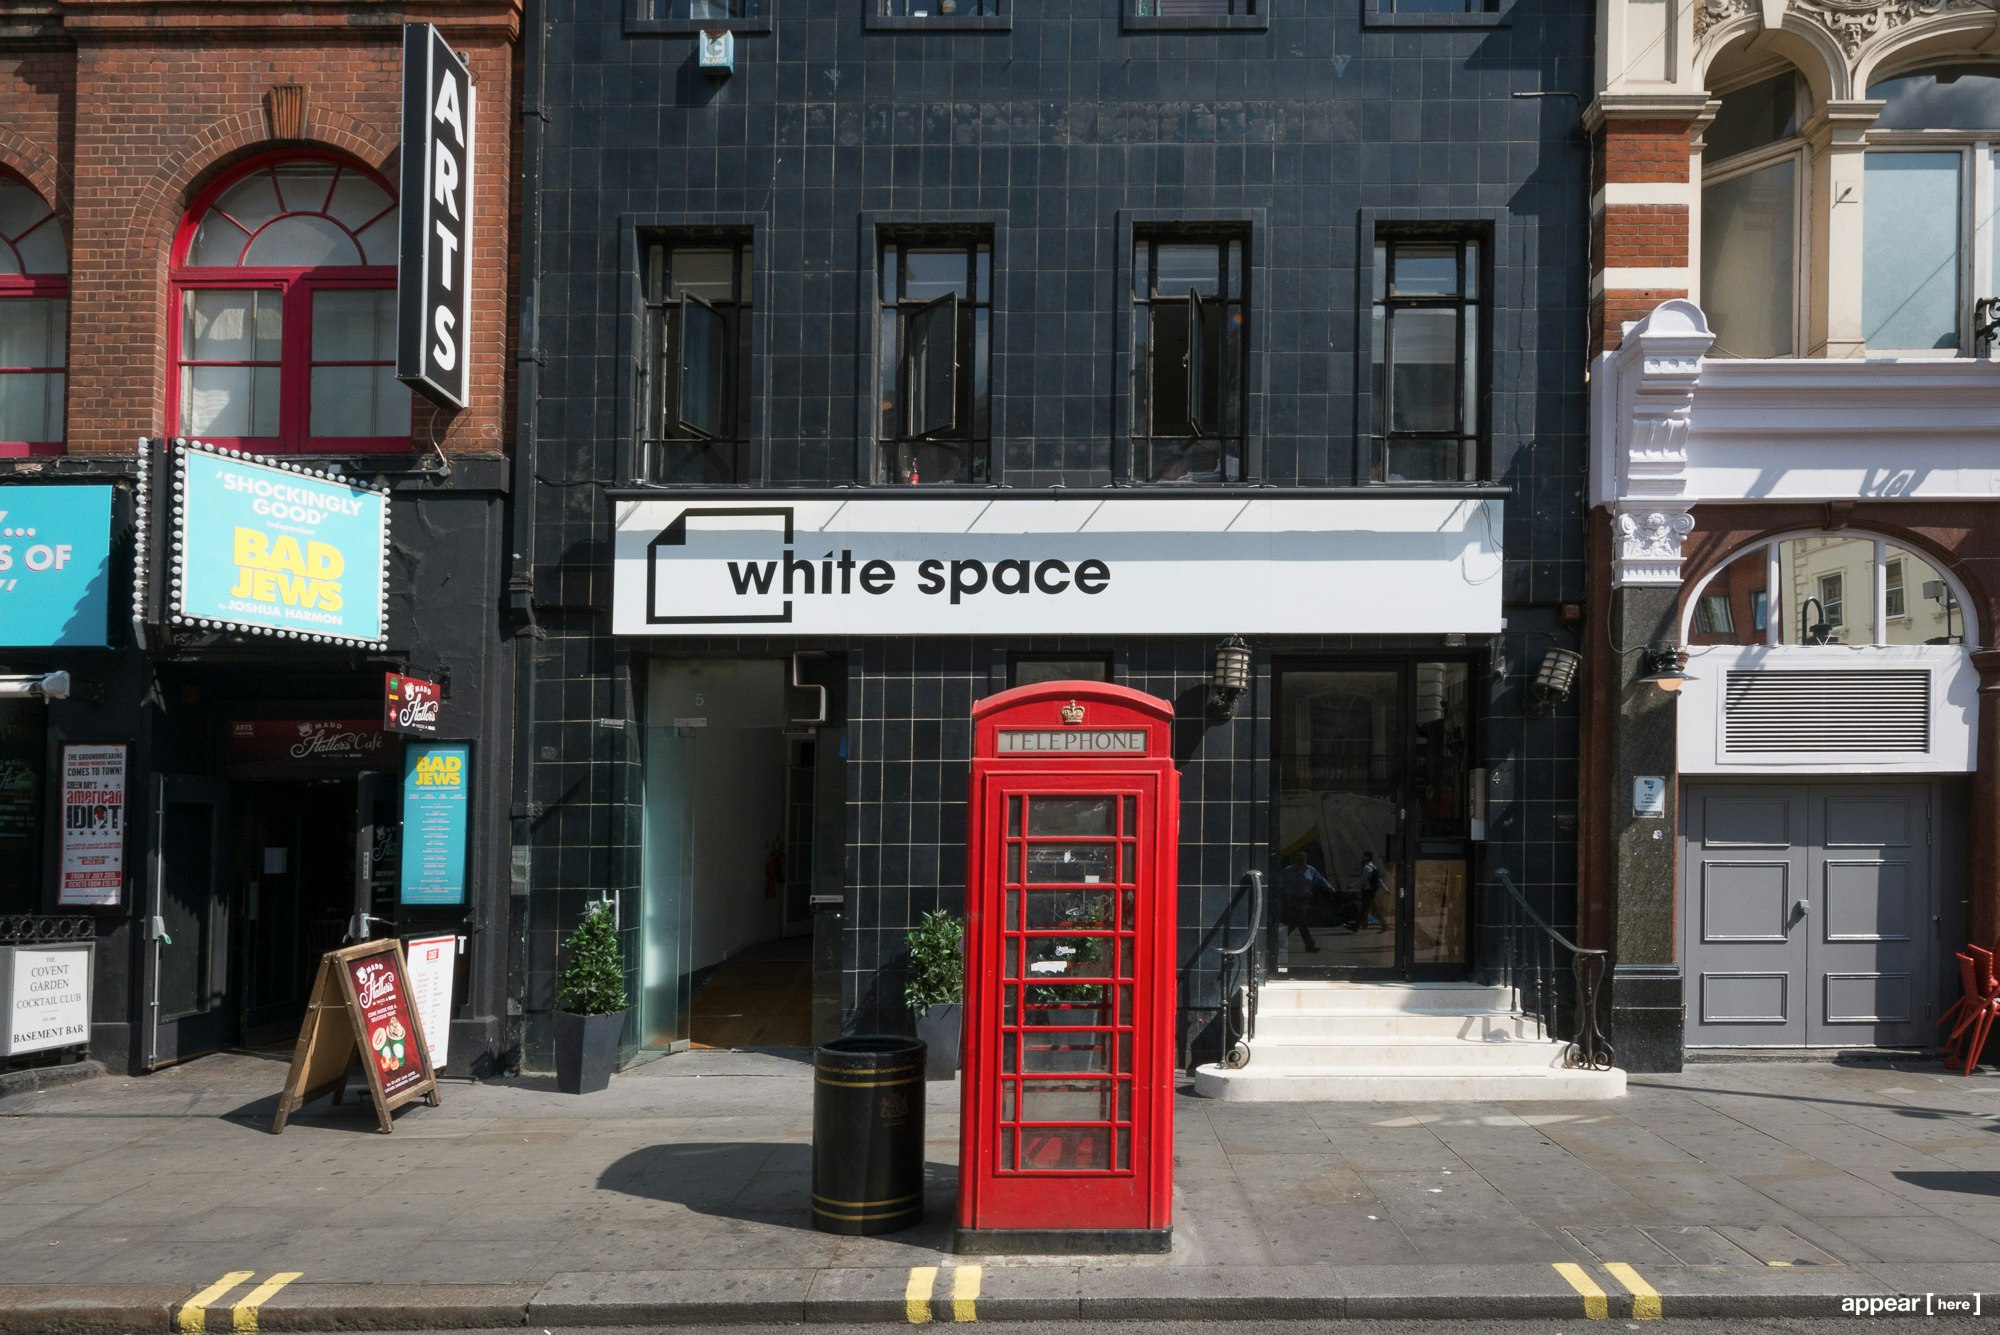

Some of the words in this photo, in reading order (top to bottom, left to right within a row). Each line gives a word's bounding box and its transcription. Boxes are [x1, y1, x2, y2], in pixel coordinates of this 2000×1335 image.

[432, 68, 465, 372] ARTS
[266, 520, 315, 536] Independent
[24, 544, 73, 572] OF
[233, 526, 345, 581] BAD
[727, 549, 896, 595] white
[917, 559, 1111, 605] space
[230, 566, 344, 612] JEWS
[227, 600, 281, 617] JOSHUA
[284, 607, 343, 625] HARMON
[1005, 733, 1141, 750] TELEPHONE
[68, 753, 77, 761] THE
[79, 752, 123, 761] GROUNDBREAKING
[416, 756, 462, 773] BAD
[67, 767, 90, 776] COMES
[92, 767, 100, 776] TO
[102, 766, 122, 776] TOWN!
[415, 772, 461, 786] JEWS
[66, 790, 122, 804] american
[66, 805, 122, 829] IDIOT
[31, 964, 70, 977] COVENT
[30, 978, 69, 992] GARDEN
[16, 995, 58, 1009] COCKTAIL
[60, 993, 82, 1004] CLUB
[13, 1027, 64, 1043] BASEMENT
[66, 1024, 84, 1035] BAR
